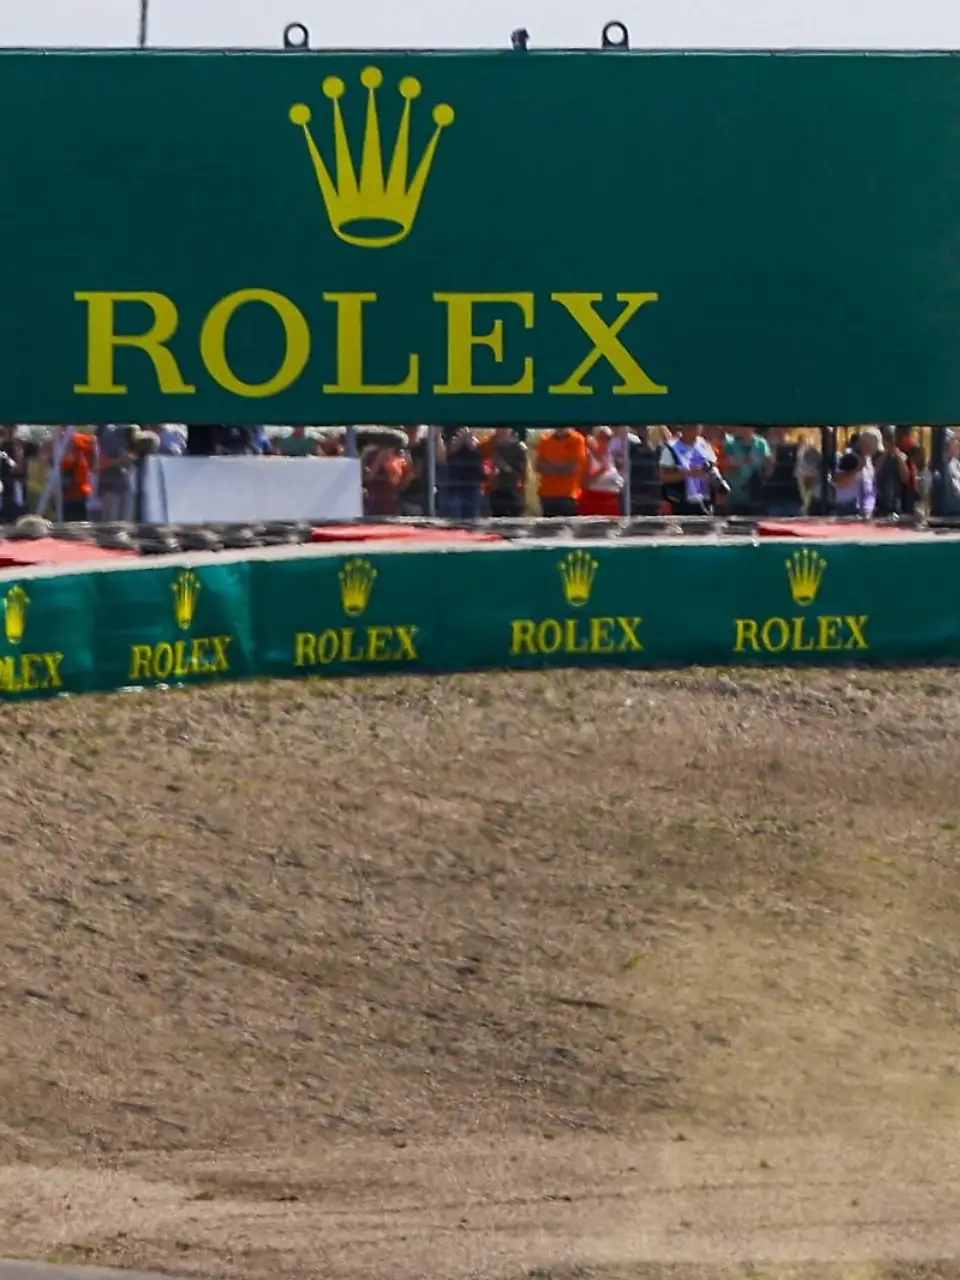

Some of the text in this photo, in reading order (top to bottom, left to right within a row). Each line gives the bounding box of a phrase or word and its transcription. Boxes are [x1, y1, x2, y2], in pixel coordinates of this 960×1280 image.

[74, 288, 669, 398] ROLEX
[294, 625, 418, 667] ROLEX
[510, 616, 645, 655] ROLEX
[734, 615, 869, 652] ROLEX
[129, 635, 233, 680] ROLEX
